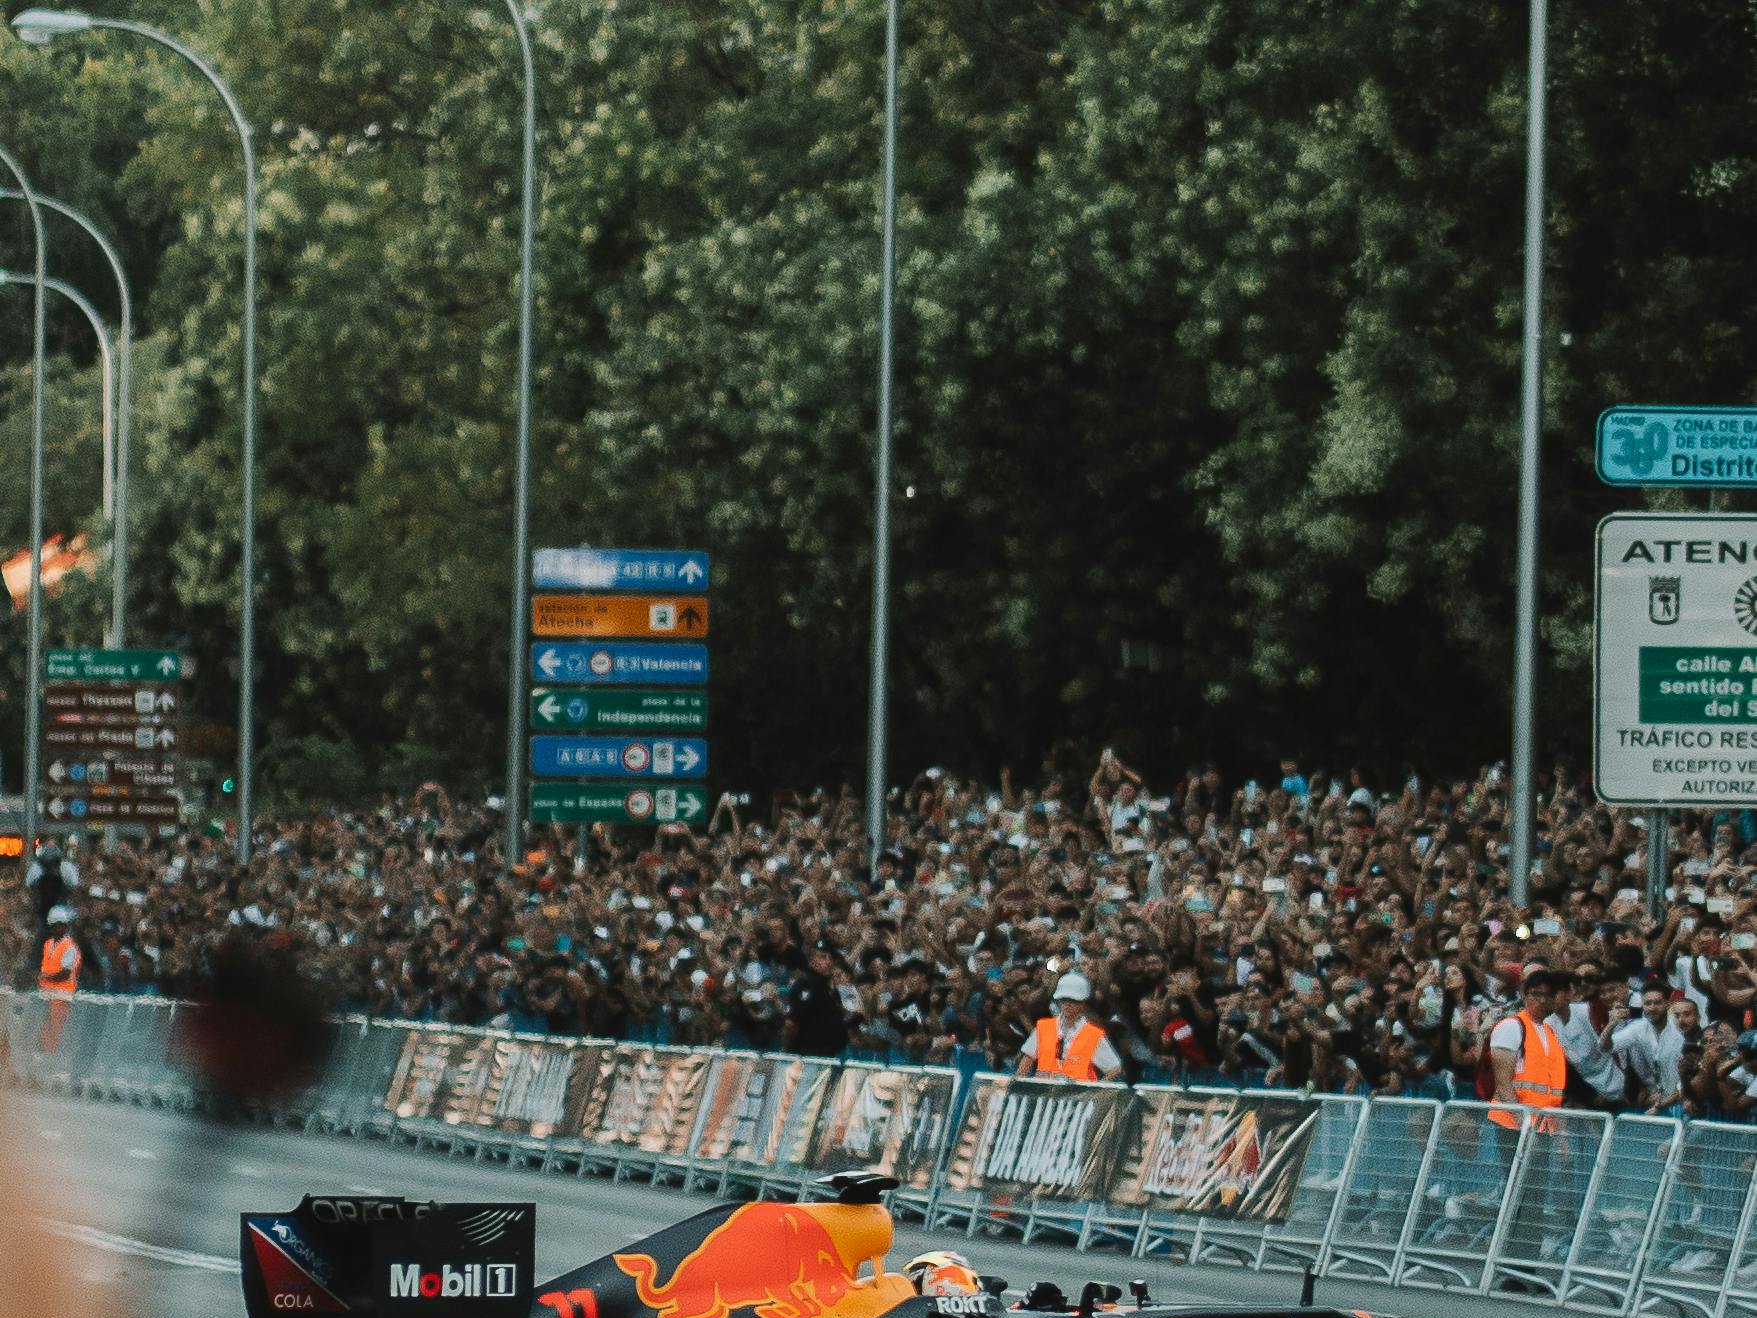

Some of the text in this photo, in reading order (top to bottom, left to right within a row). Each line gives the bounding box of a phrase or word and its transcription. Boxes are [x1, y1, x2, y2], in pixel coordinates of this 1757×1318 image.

[1673, 418, 1714, 433] ZONA
[1719, 420, 1738, 433] DE
[1676, 436, 1696, 448] DE
[1672, 454, 1757, 477] Distrit
[1621, 540, 1757, 564] ATEN
[1676, 655, 1757, 673] calle A
[1659, 678, 1744, 695] sentido
[1704, 700, 1738, 717] del
[1616, 727, 1711, 748] TRÁFICO
[1652, 759, 1731, 773] EXCEPTO
[390, 1264, 481, 1298] Mobil
[273, 1294, 315, 1308] COLA
[935, 1296, 988, 1314] ROKT
